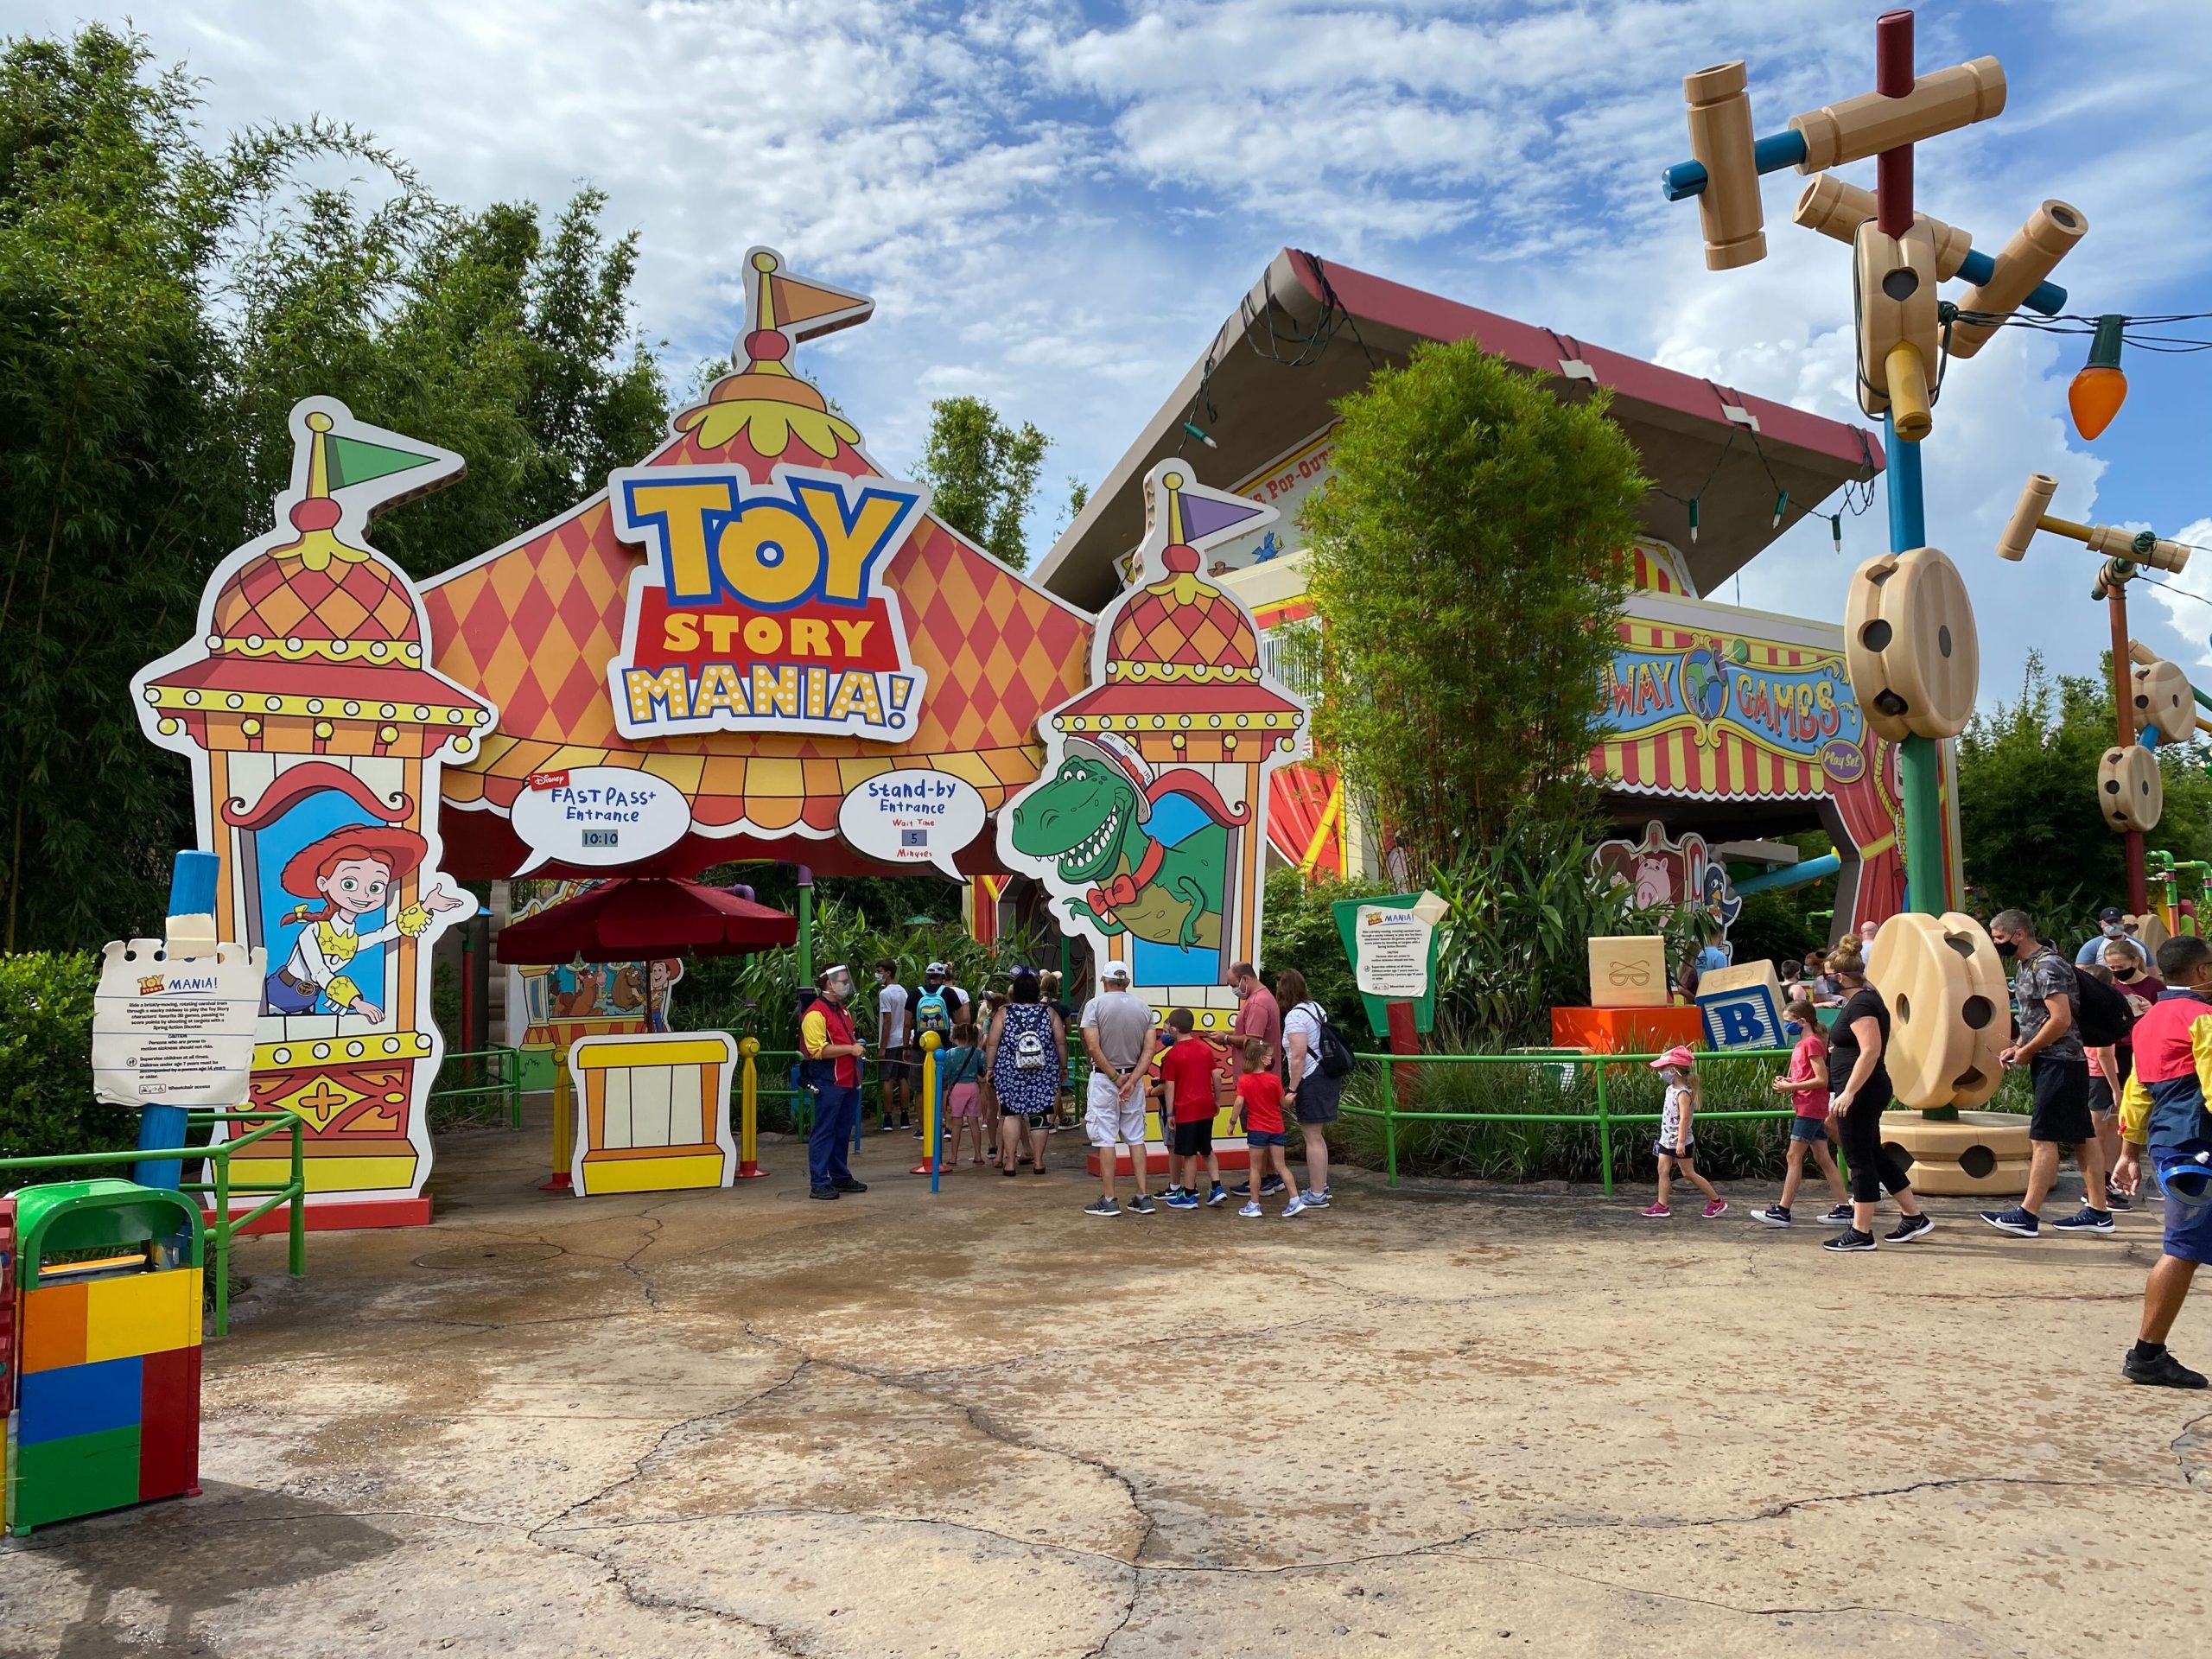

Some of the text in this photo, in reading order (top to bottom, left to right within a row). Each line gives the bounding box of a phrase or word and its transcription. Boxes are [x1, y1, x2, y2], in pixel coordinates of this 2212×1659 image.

[622, 475, 920, 612] TOY
[663, 613, 874, 658] STORY
[621, 662, 915, 729] MANIA!
[1735, 671, 1841, 741] GAMES
[1824, 751, 1859, 770] Play Set
[551, 787, 601, 804] FAST
[868, 779, 956, 798] Stand-by
[567, 806, 639, 822] Entrance
[880, 798, 945, 814] Entrance
[893, 818, 935, 827] Wait Time
[584, 832, 618, 844] 10:10
[911, 833, 918, 843] 5
[897, 849, 932, 858] Minutes
[1385, 913, 1414, 922] MANIA!
[137, 975, 217, 989] TOY MANIA!
[1713, 1001, 1765, 1044] B
